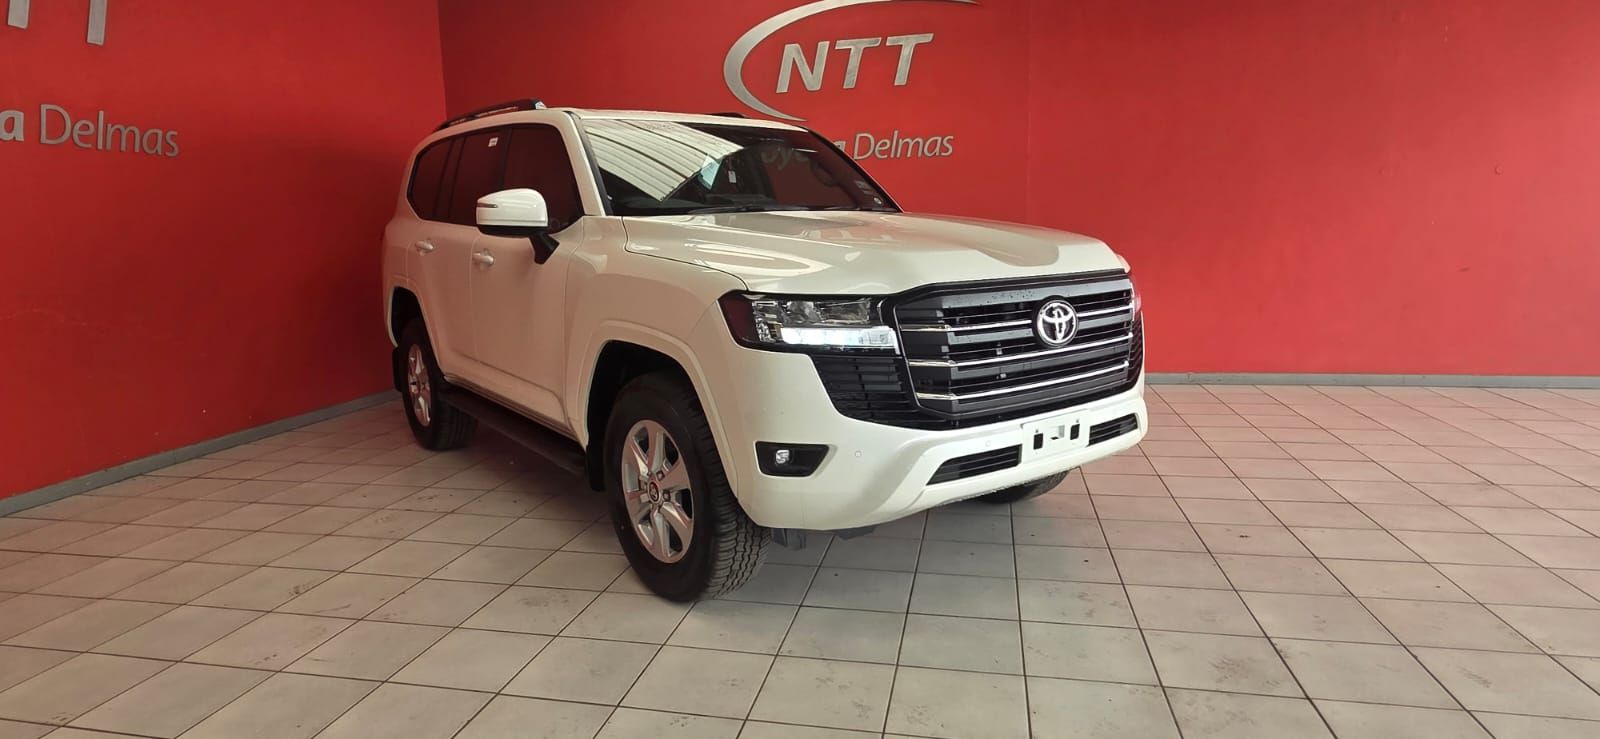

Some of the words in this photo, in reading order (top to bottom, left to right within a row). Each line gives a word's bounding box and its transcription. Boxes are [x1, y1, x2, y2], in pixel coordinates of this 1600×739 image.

[776, 33, 934, 93] NTT
[39, 103, 180, 157] Delmas
[853, 130, 954, 160] Delmas
